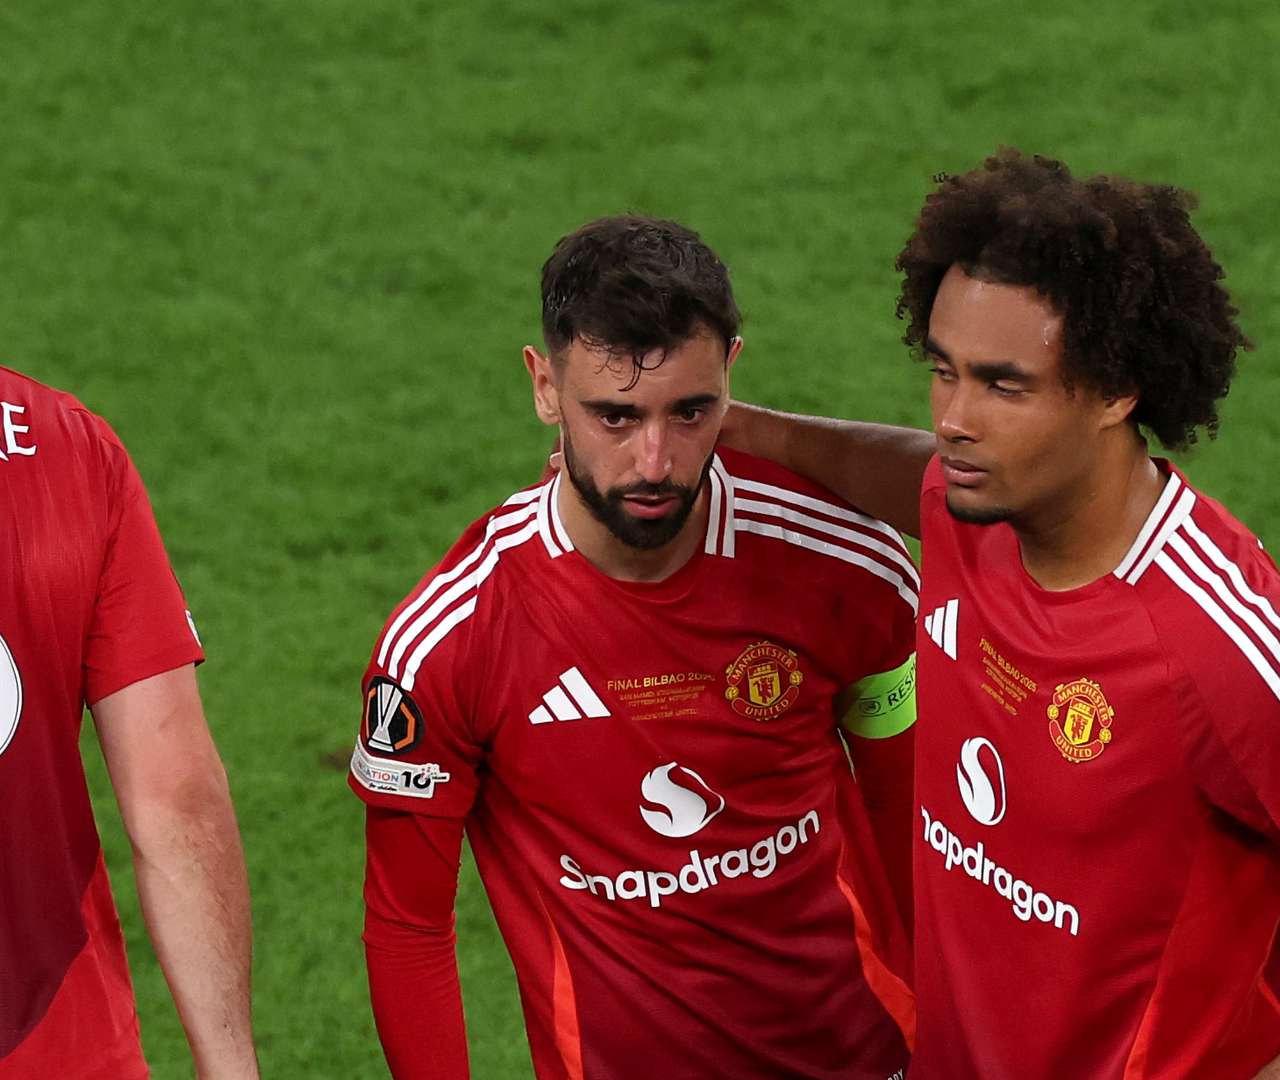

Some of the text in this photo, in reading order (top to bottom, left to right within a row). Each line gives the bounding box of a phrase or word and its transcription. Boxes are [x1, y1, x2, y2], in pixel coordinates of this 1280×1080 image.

[732, 647, 793, 679] MANCHESTER
[607, 679, 641, 691] FINAL
[643, 673, 685, 687] BILBAO
[745, 699, 789, 716] UNITED
[1057, 685, 1108, 721] MANCHESTER
[1056, 735, 1092, 757] UNITED
[365, 769, 399, 782] ATION
[560, 810, 820, 907] Snapdragon
[921, 805, 1079, 936] napdragon
